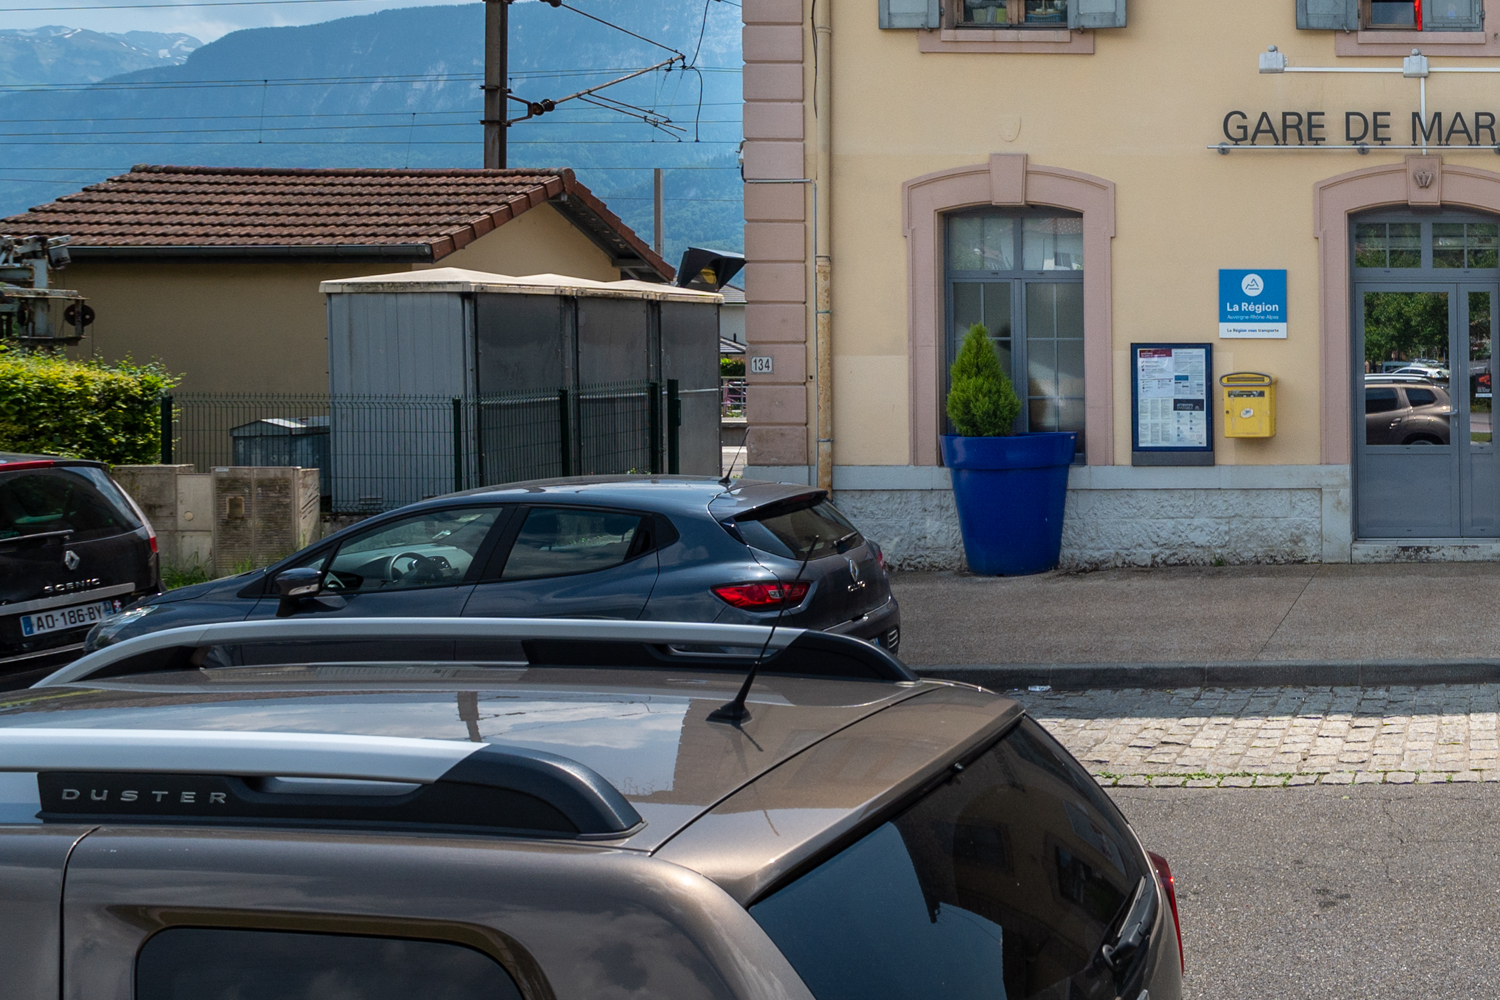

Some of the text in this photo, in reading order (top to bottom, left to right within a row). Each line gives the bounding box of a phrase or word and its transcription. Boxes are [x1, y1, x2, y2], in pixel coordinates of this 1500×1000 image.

[1222, 110, 1326, 142] GARE
[1345, 111, 1392, 142] DE
[1226, 302, 1279, 313] La Région
[753, 358, 770, 371] 134
[43, 578, 101, 593] SCENIC
[36, 604, 103, 632] AD-186-BY
[61, 788, 227, 804] DUSTER
